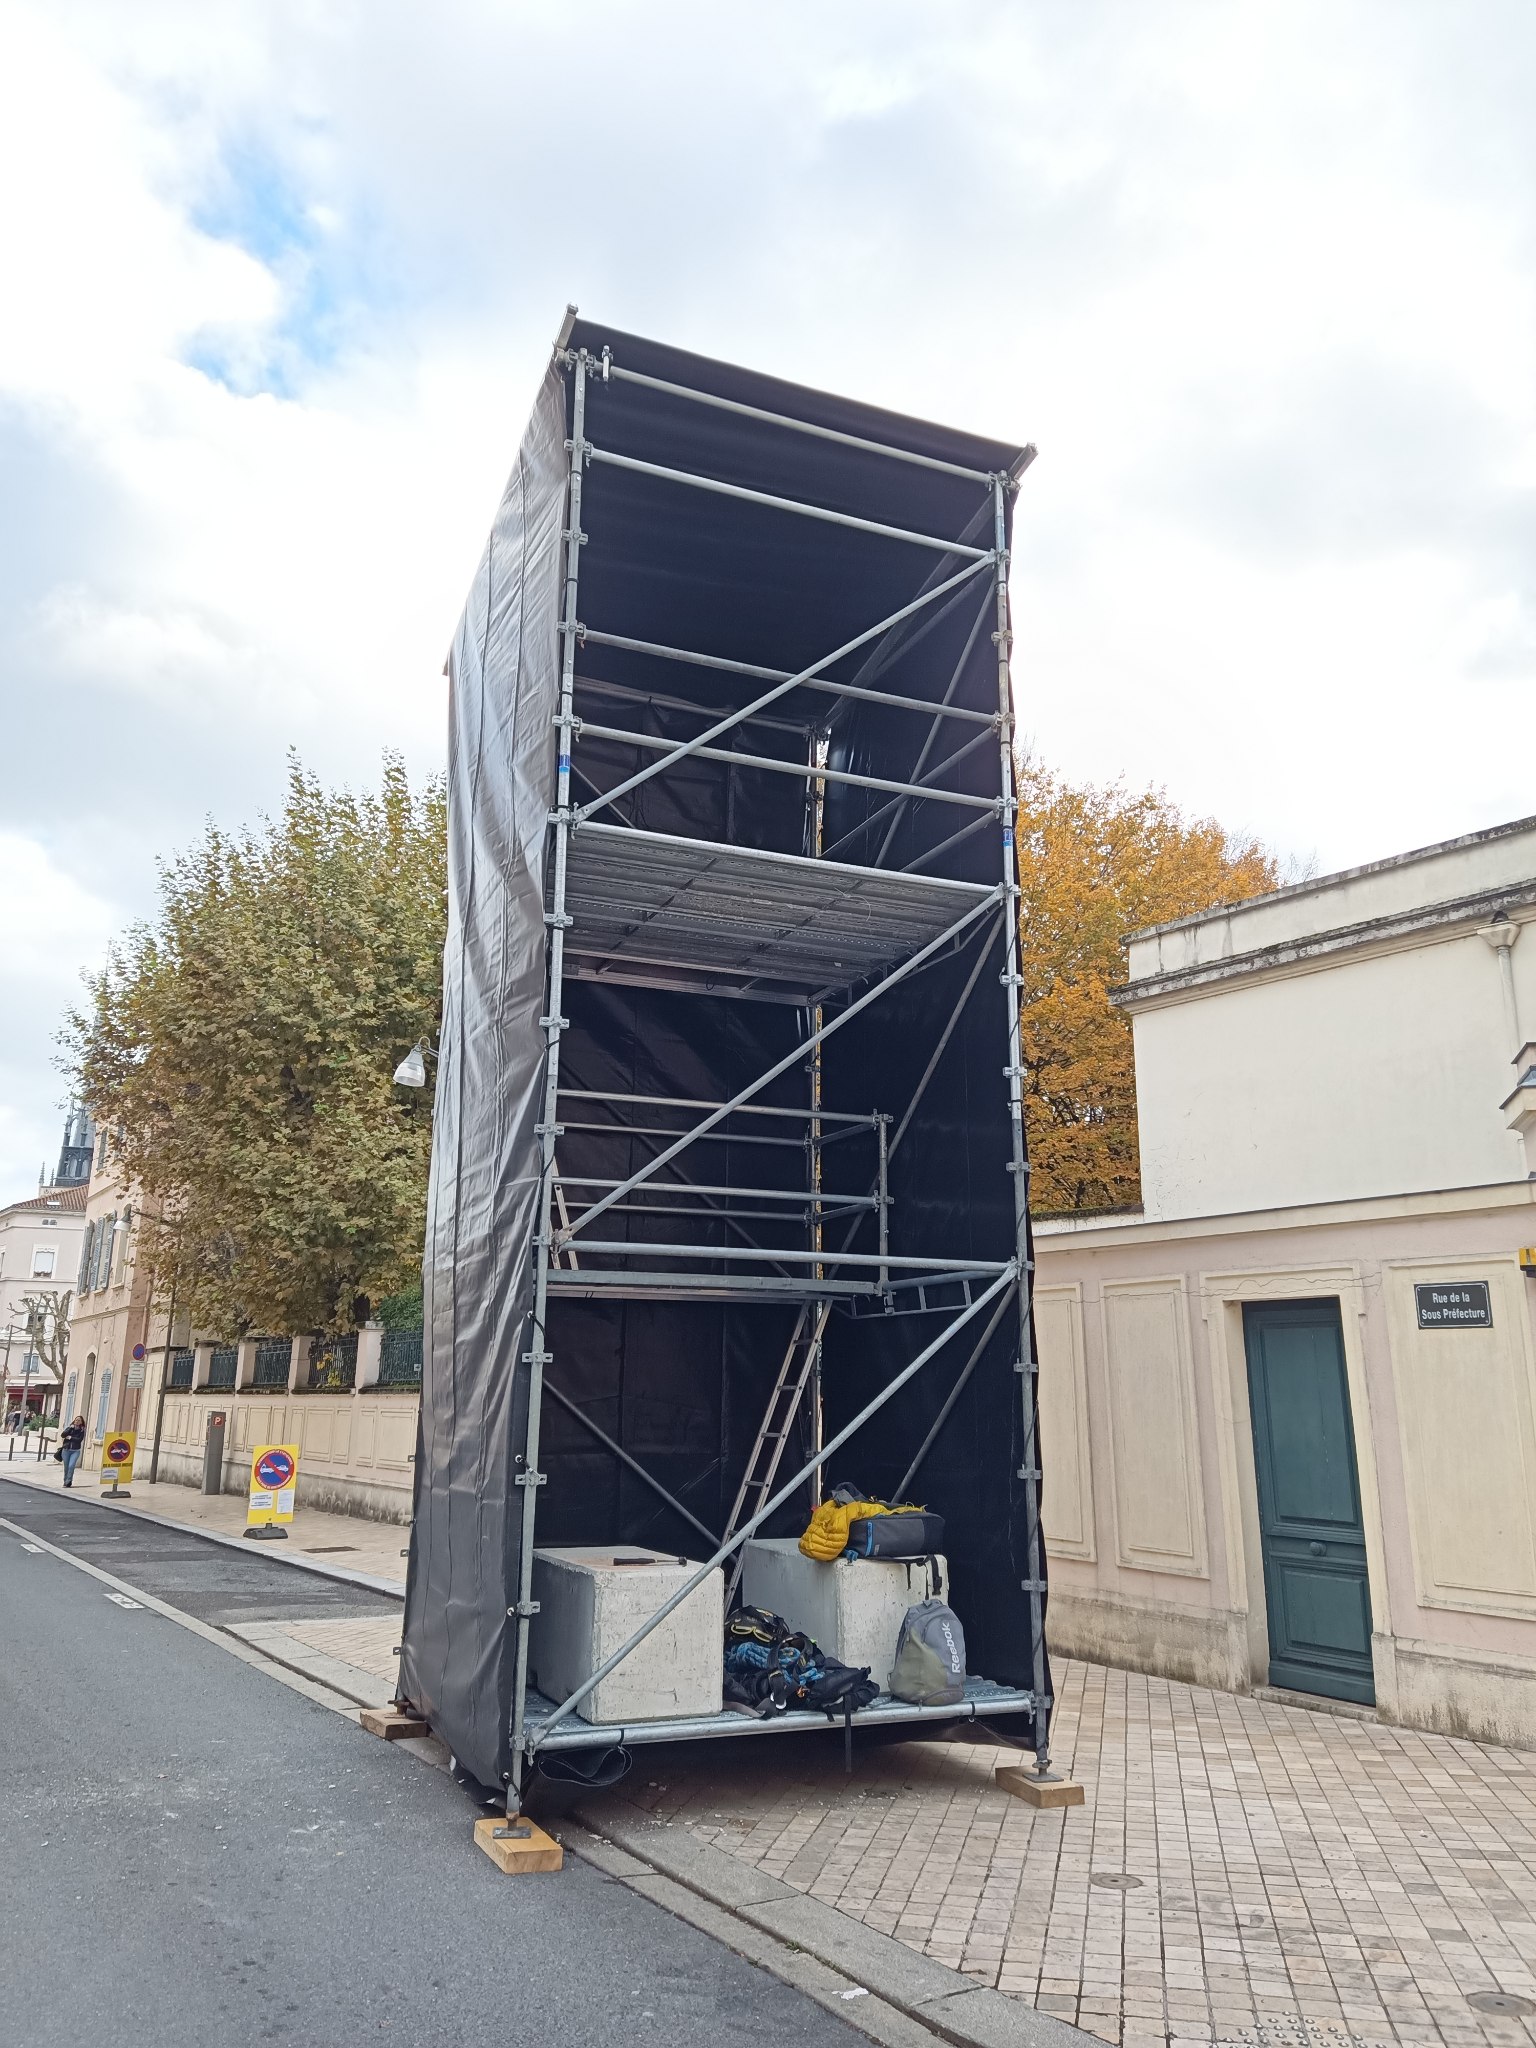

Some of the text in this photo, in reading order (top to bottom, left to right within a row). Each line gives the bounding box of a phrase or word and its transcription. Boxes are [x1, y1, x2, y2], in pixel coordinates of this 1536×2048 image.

[1432, 1292, 1470, 1303] Rue de la
[1421, 1307, 1486, 1320] Sous Préfecture
[214, 1416, 222, 1425] P
[941, 1621, 961, 1673] Reebok
